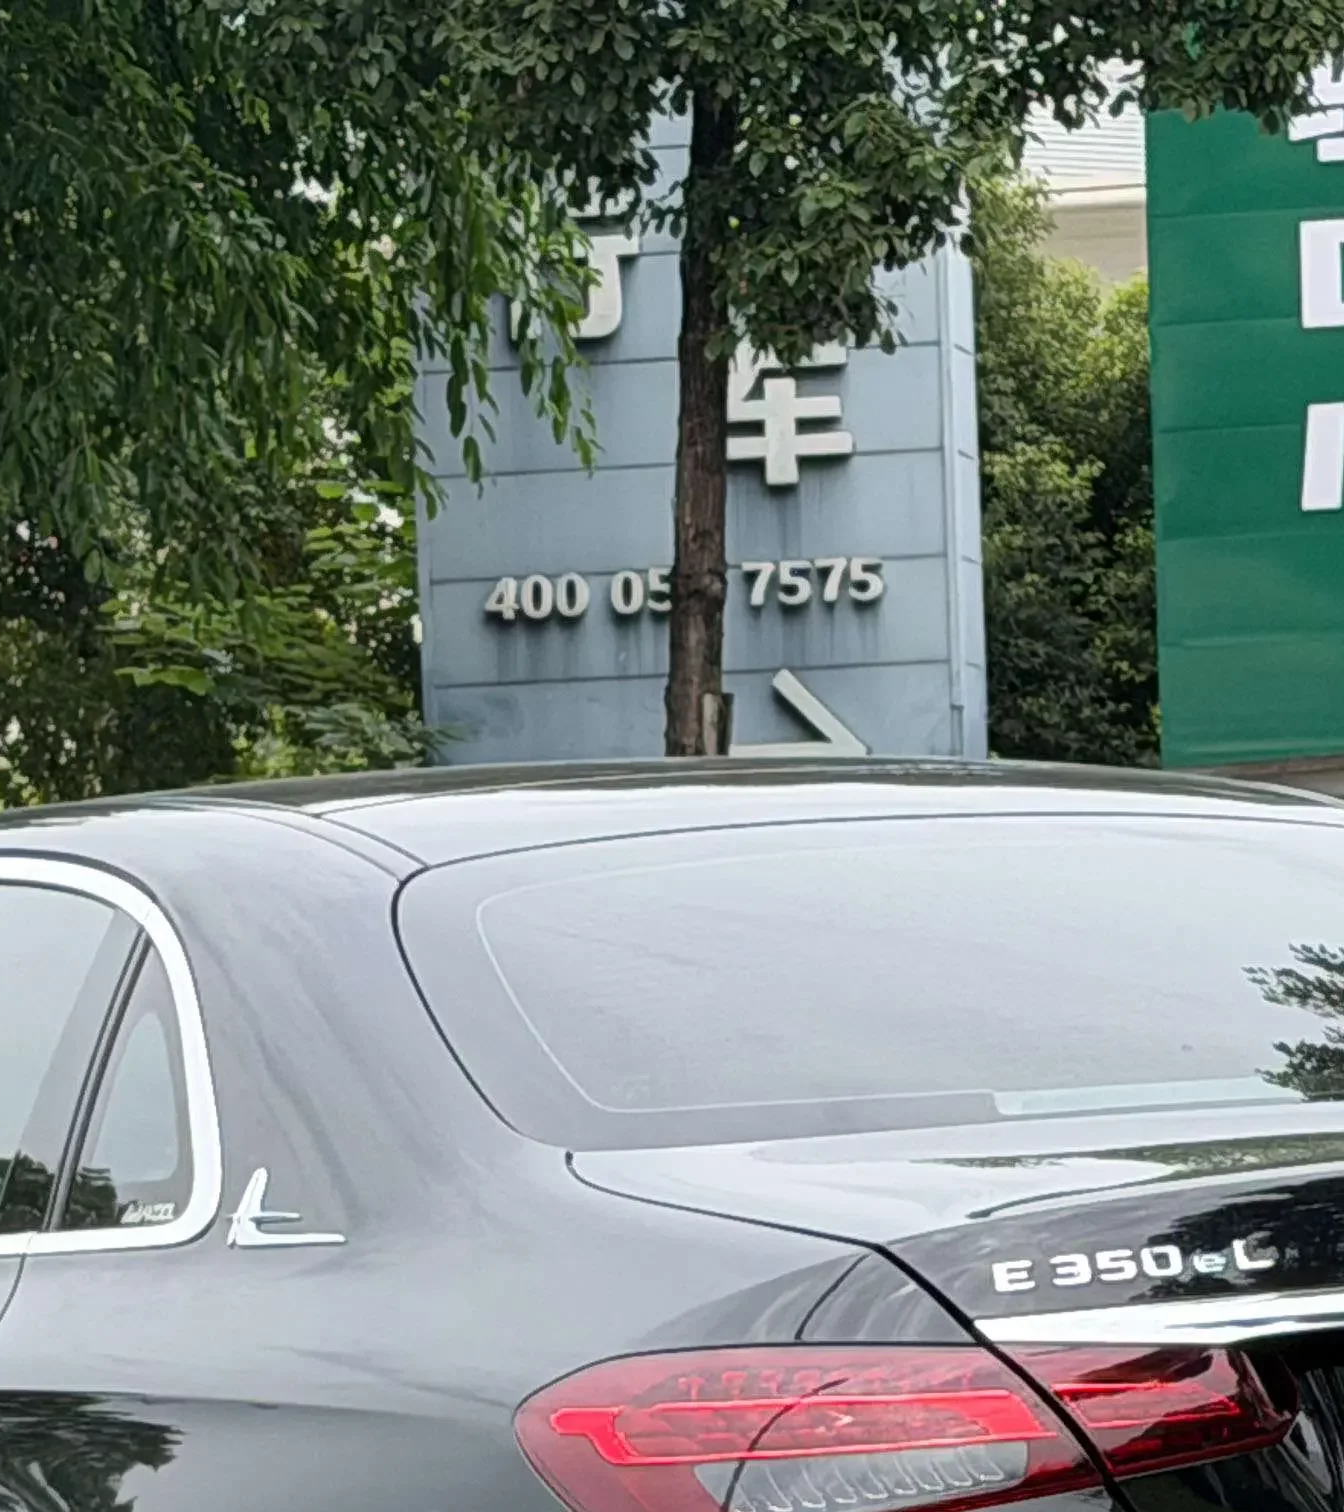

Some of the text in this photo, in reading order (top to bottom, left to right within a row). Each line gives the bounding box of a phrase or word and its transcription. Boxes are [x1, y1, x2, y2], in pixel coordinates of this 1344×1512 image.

[484, 571, 590, 621] 400
[741, 555, 885, 607] 7575
[991, 1258, 1036, 1292] E
